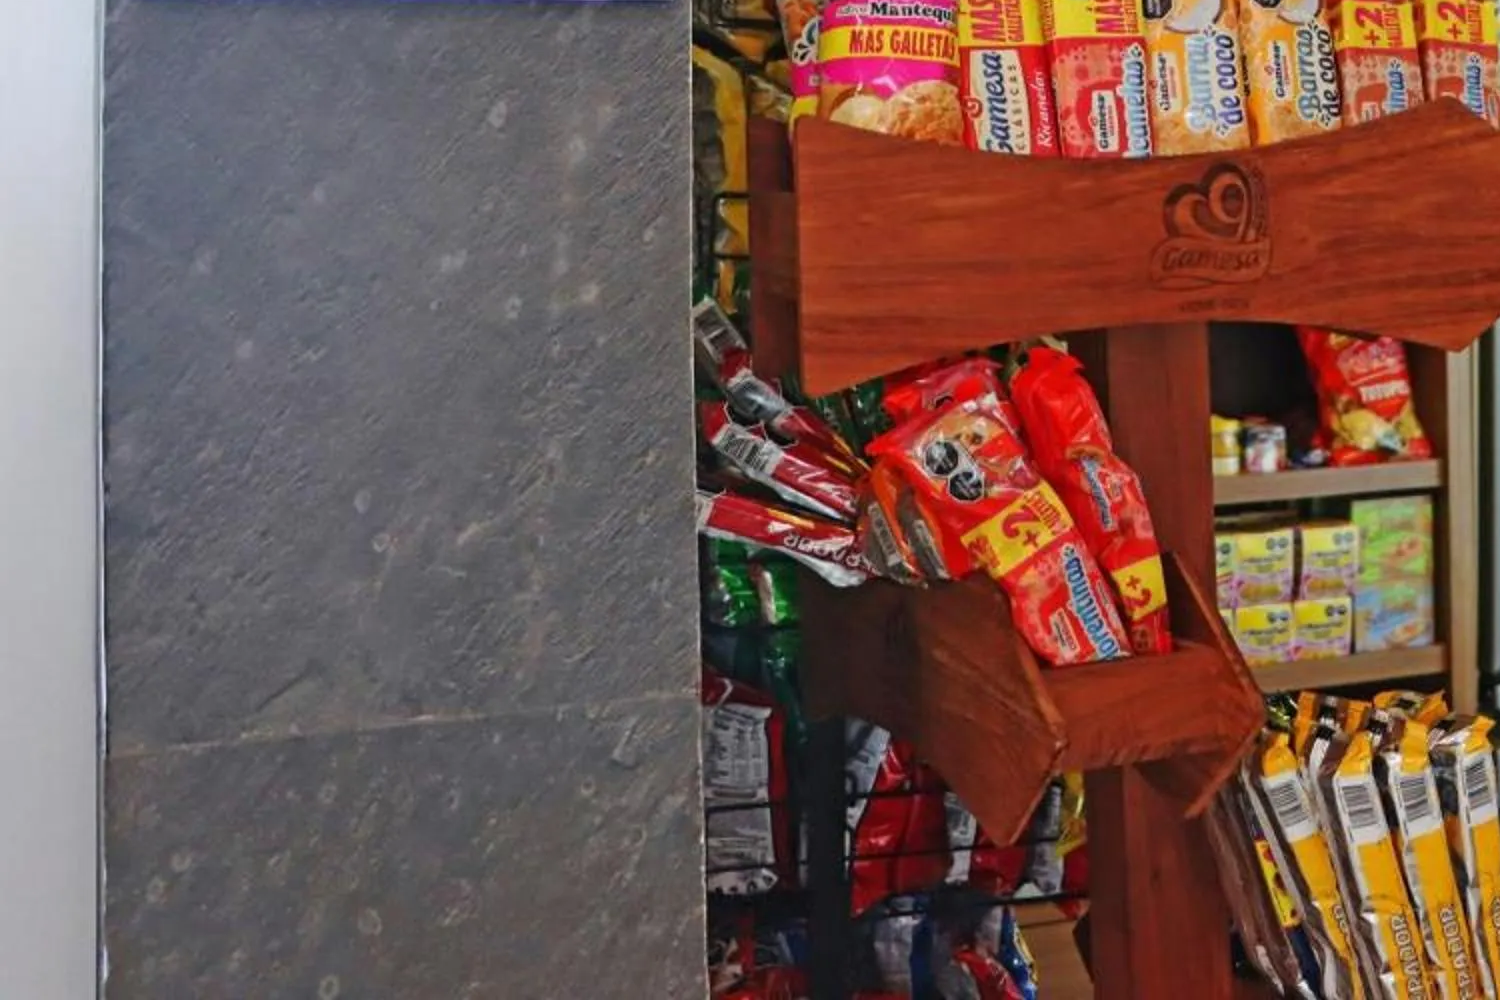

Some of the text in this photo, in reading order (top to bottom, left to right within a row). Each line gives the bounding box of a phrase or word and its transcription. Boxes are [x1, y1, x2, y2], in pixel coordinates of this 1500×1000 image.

[1214, 33, 1244, 126] de coco
[1296, 28, 1322, 120] Barras
[1316, 28, 1338, 87] coco
[1070, 549, 1123, 661] lorentinas
